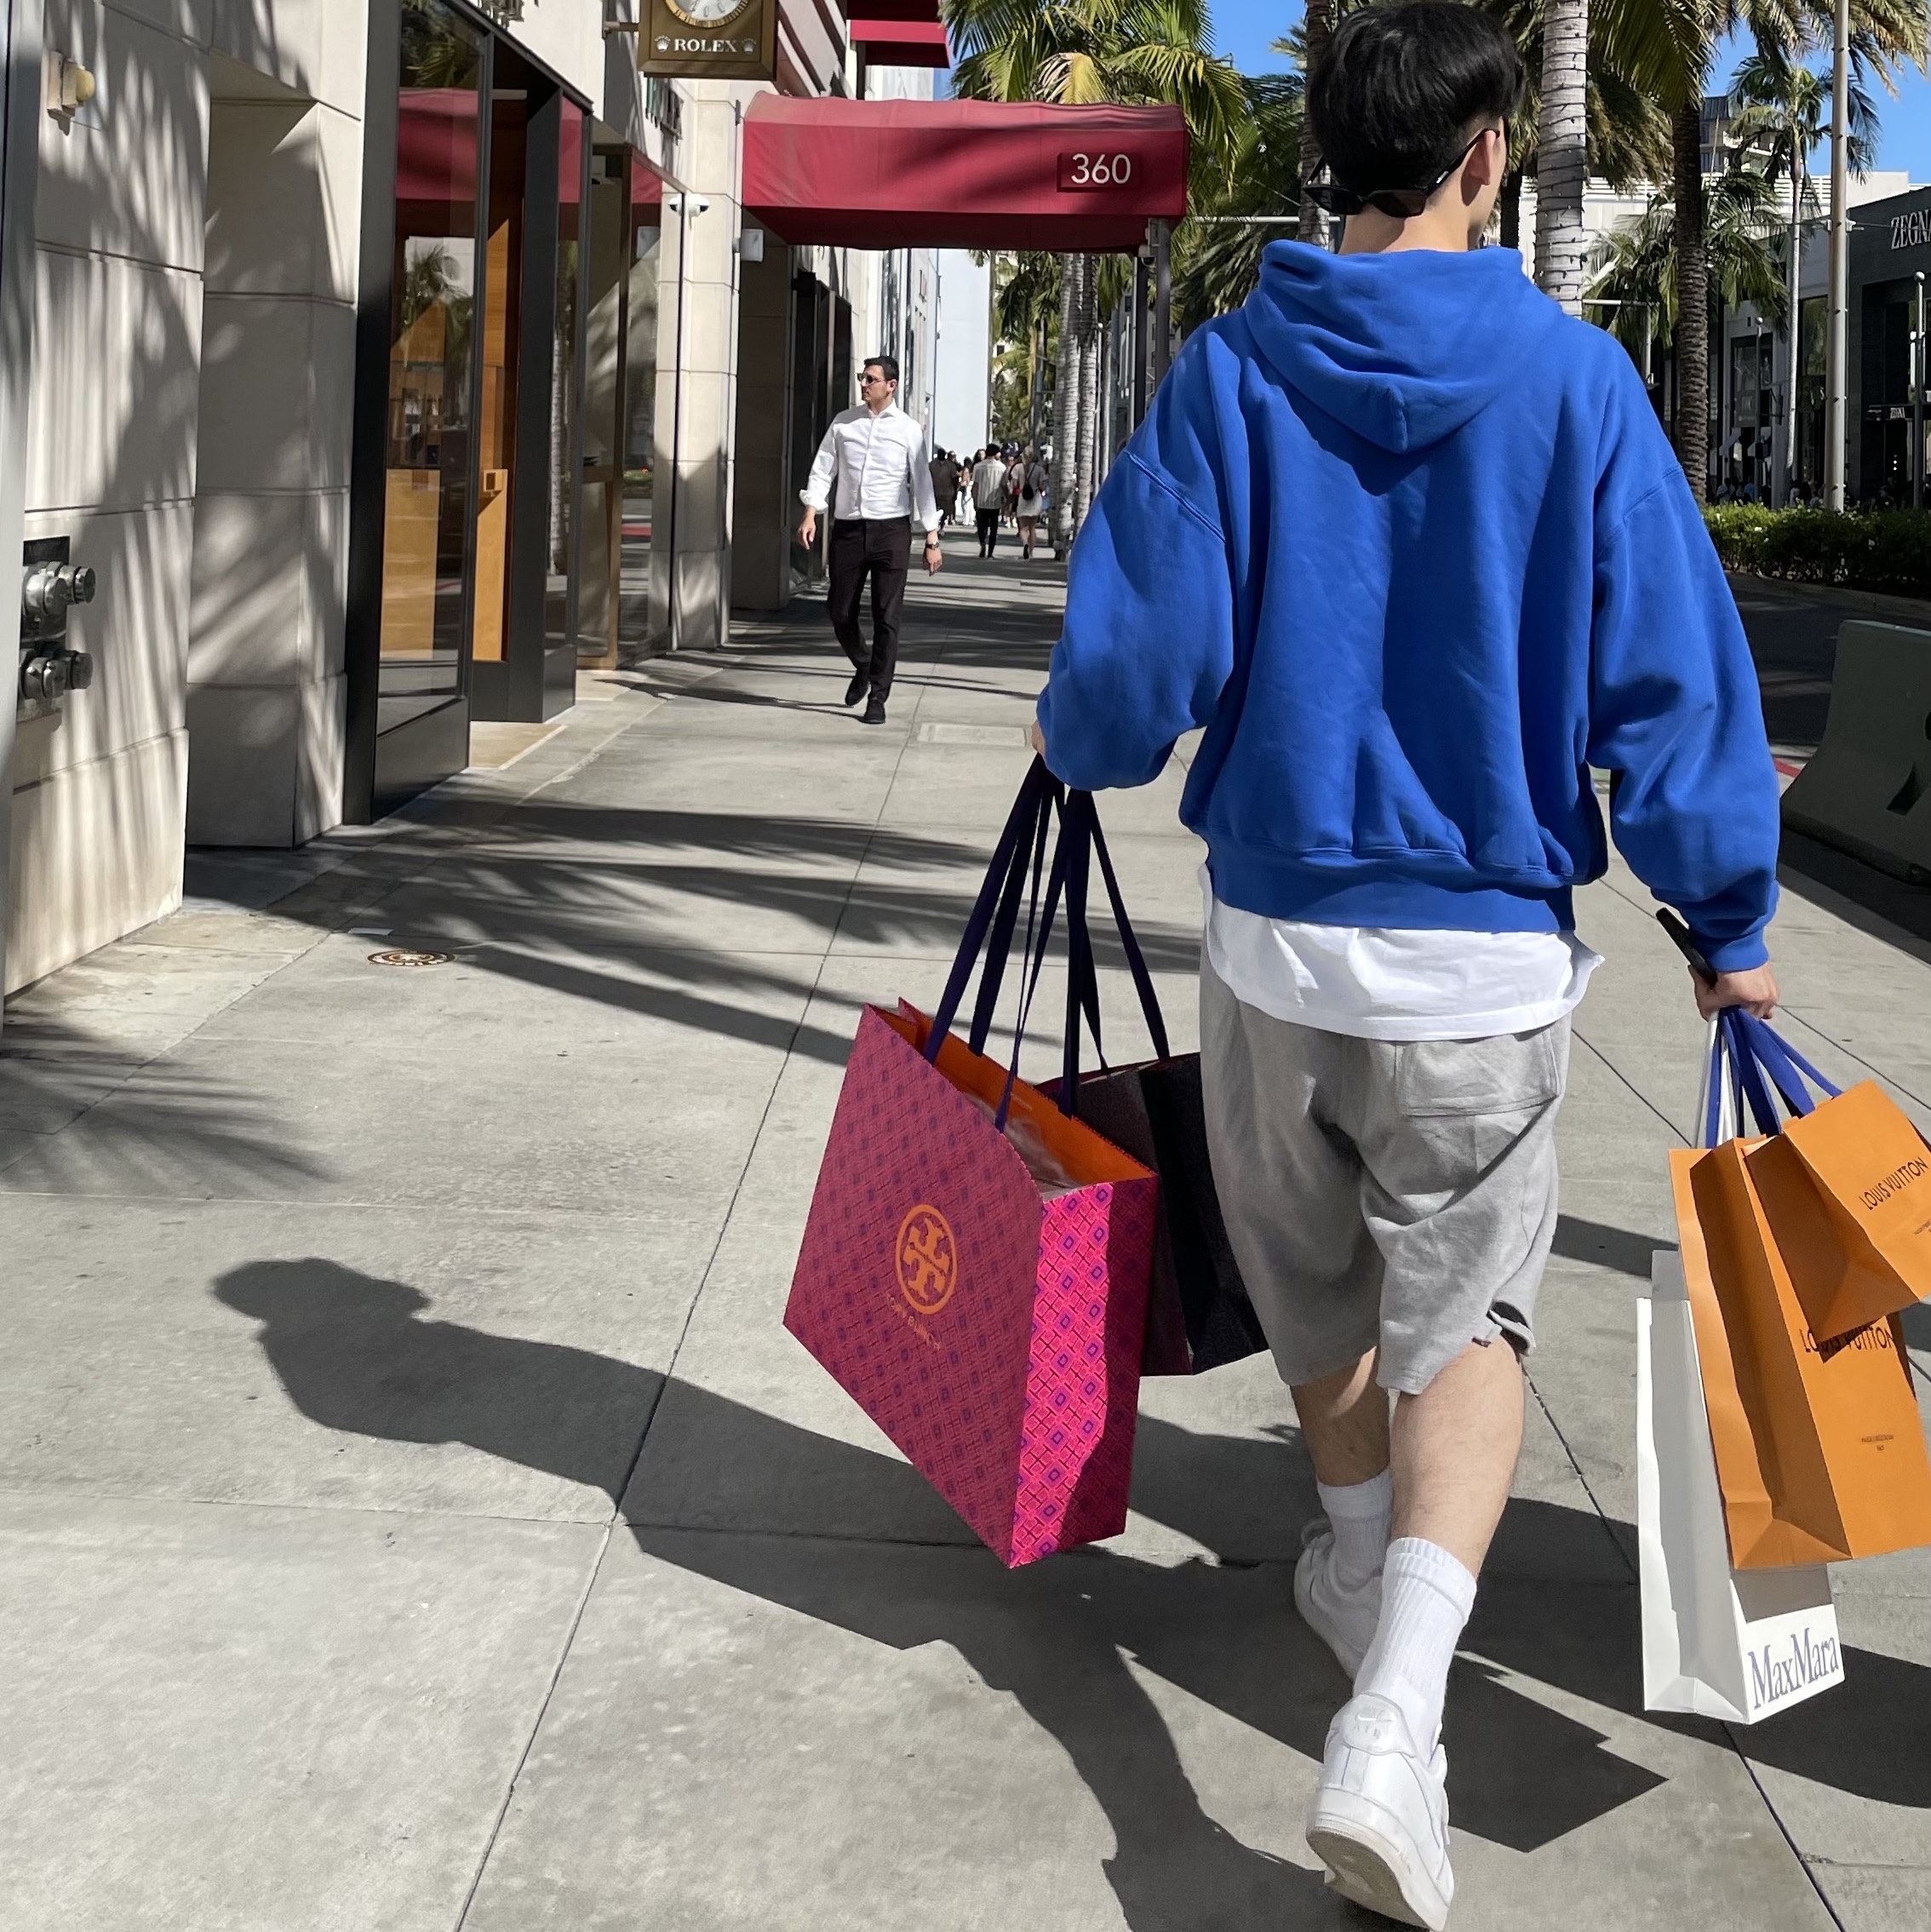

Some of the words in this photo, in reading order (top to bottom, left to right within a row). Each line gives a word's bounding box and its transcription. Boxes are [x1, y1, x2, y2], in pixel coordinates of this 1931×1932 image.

[673, 38, 738, 52] ROLEX
[1071, 152, 1132, 184] 360
[1858, 1182, 1891, 1211] LOUIS
[1882, 1156, 1929, 1192] VUITTON
[1747, 1627, 1839, 1710] MaxMara
